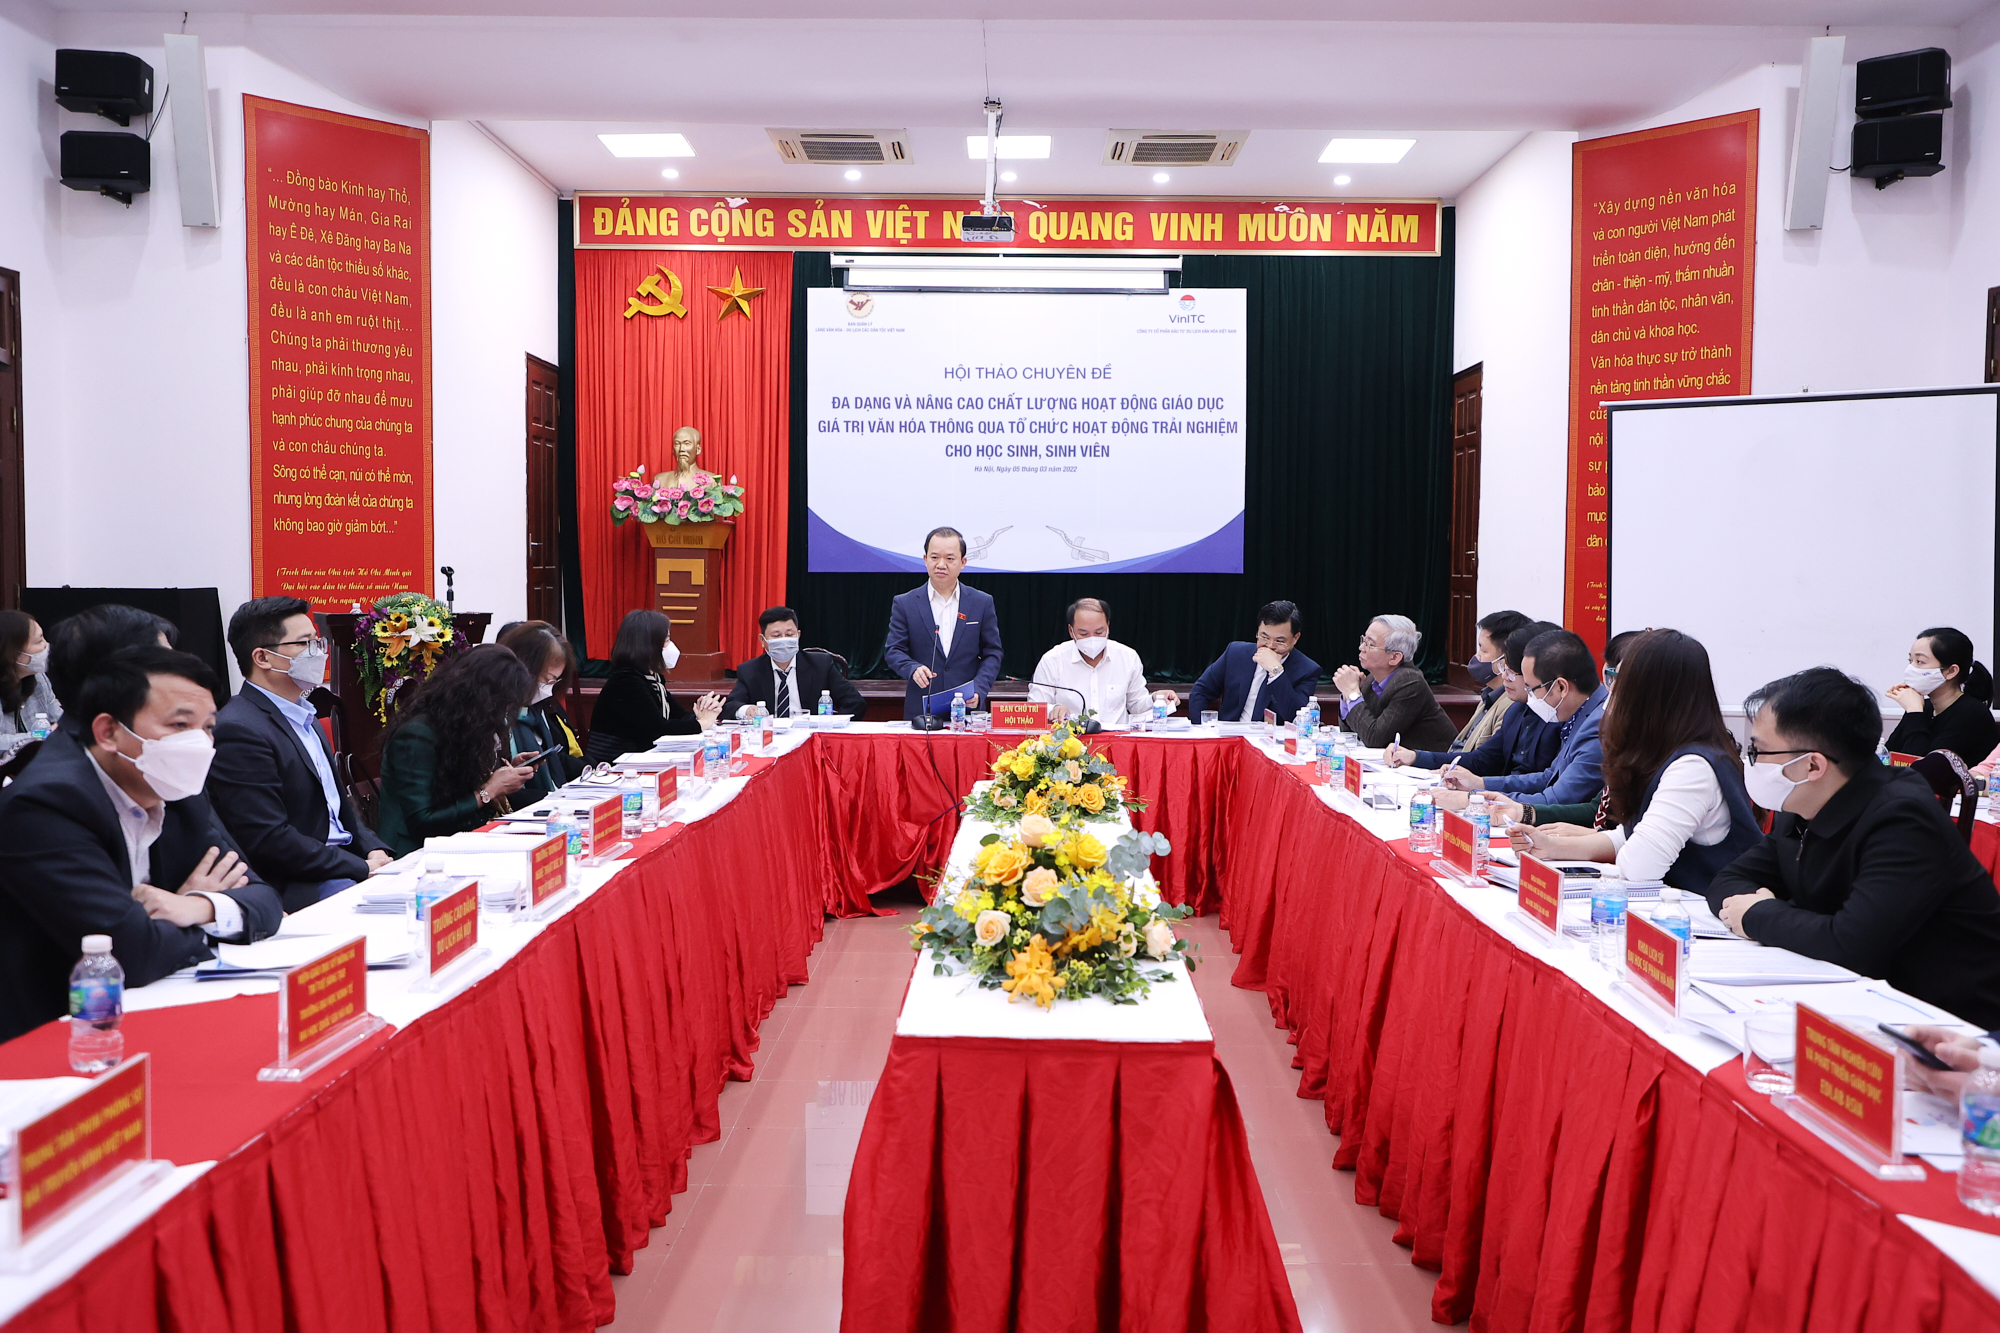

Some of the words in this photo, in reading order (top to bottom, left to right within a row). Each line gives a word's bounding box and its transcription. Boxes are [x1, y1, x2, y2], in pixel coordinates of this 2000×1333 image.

[286, 169, 315, 191] Đồng
[319, 177, 338, 192] bào
[341, 181, 364, 195] Kinh
[368, 185, 386, 202] hay
[388, 188, 410, 204] Thổ,
[1624, 197, 1655, 211] dựng
[1660, 188, 1681, 205] nền
[1686, 187, 1708, 200] văn
[1713, 182, 1736, 196] hóa
[268, 194, 310, 217] Mường
[315, 203, 335, 220] hay
[340, 206, 367, 224] Mán,
[371, 211, 390, 226] Gia
[394, 215, 411, 229] Rai
[593, 198, 678, 236] ĐẢNG
[691, 202, 774, 242] CỘNG
[788, 199, 852, 237] SẢN
[867, 204, 929, 244] VIỆT
[1593, 228, 1605, 240] và
[1607, 228, 1625, 239] con
[1628, 220, 1658, 238] người
[1661, 217, 1681, 232] Việt
[1684, 215, 1708, 228] Nam
[1712, 209, 1736, 227] phát
[1029, 211, 1133, 242] QUANG
[1151, 213, 1223, 241] VINH
[1239, 208, 1331, 241] MUÔN
[1347, 208, 1418, 242] NĂM
[269, 222, 287, 240] hay
[290, 222, 297, 238] Ê
[300, 226, 317, 242] Đê,
[320, 230, 333, 244] Xê
[336, 232, 361, 251] Đăng
[364, 237, 381, 253] hay
[384, 239, 396, 253] Ba
[399, 241, 411, 255] Na
[1593, 250, 1615, 266] triển
[1618, 250, 1641, 263] toàn
[1644, 246, 1670, 260] diện,
[1674, 241, 1711, 255] hướng
[1714, 233, 1735, 250] đến
[1592, 305, 1609, 318] tinh
[1612, 300, 1634, 316] thần
[1637, 299, 1656, 313] dân
[1659, 297, 1678, 312] tộc,
[1681, 293, 1708, 308] nhân
[1711, 291, 1734, 304] văn,
[1169, 314, 1205, 323] VinITC
[1591, 330, 1609, 344] dân
[1613, 327, 1631, 341] chủ
[1634, 326, 1646, 339] và
[1649, 325, 1674, 337] khoa
[1678, 323, 1700, 336] học.
[1591, 356, 1611, 369] Văn
[1614, 354, 1633, 367] hóa
[1637, 352, 1661, 366] thực
[1664, 352, 1678, 364] sự
[1681, 347, 1697, 361] trở
[1700, 344, 1732, 359] thành
[944, 364, 970, 382] HỘI
[975, 363, 1018, 379] THẢO
[1022, 364, 1086, 379] CHUYÊN
[1091, 363, 1112, 379] ĐỀ
[831, 397, 850, 409] ĐA
[855, 397, 891, 412] DẠNG
[894, 394, 912, 409] VÀ
[916, 394, 952, 410] NÂNG
[957, 397, 984, 410] CAO
[988, 392, 1023, 410] CHẤT
[1027, 397, 1077, 413] LƯỢNG
[1082, 397, 1117, 412] HOẠT
[1120, 394, 1157, 413] ĐỘNG
[1162, 394, 1193, 410] GIÁO
[1198, 397, 1224, 412] DỤC
[818, 418, 840, 432] GIÁ
[843, 420, 864, 435] TRỊ
[868, 418, 894, 433] VĂN
[899, 418, 926, 433] HÓA
[929, 418, 973, 433] THÔNG
[978, 421, 1005, 434] QUA
[1008, 417, 1027, 433] TỔ
[1029, 418, 1068, 434] CHỨC
[1073, 421, 1107, 436] HOẠT
[1111, 418, 1148, 436] ĐỘNG
[1152, 417, 1182, 433] TRẢI
[1187, 418, 1237, 436] NGHIỆM
[945, 444, 972, 457] CHO
[976, 445, 1003, 460] HỌC
[1007, 445, 1041, 459] SINH,
[1046, 445, 1076, 457] SINH
[1080, 442, 1109, 457] VIÊN
[1000, 705, 1013, 713] BAN
[1014, 704, 1027, 713] CHỦ
[1028, 704, 1038, 713] TRÌ
[1005, 716, 1015, 726] HỘI
[1017, 715, 1034, 724] THẢO
